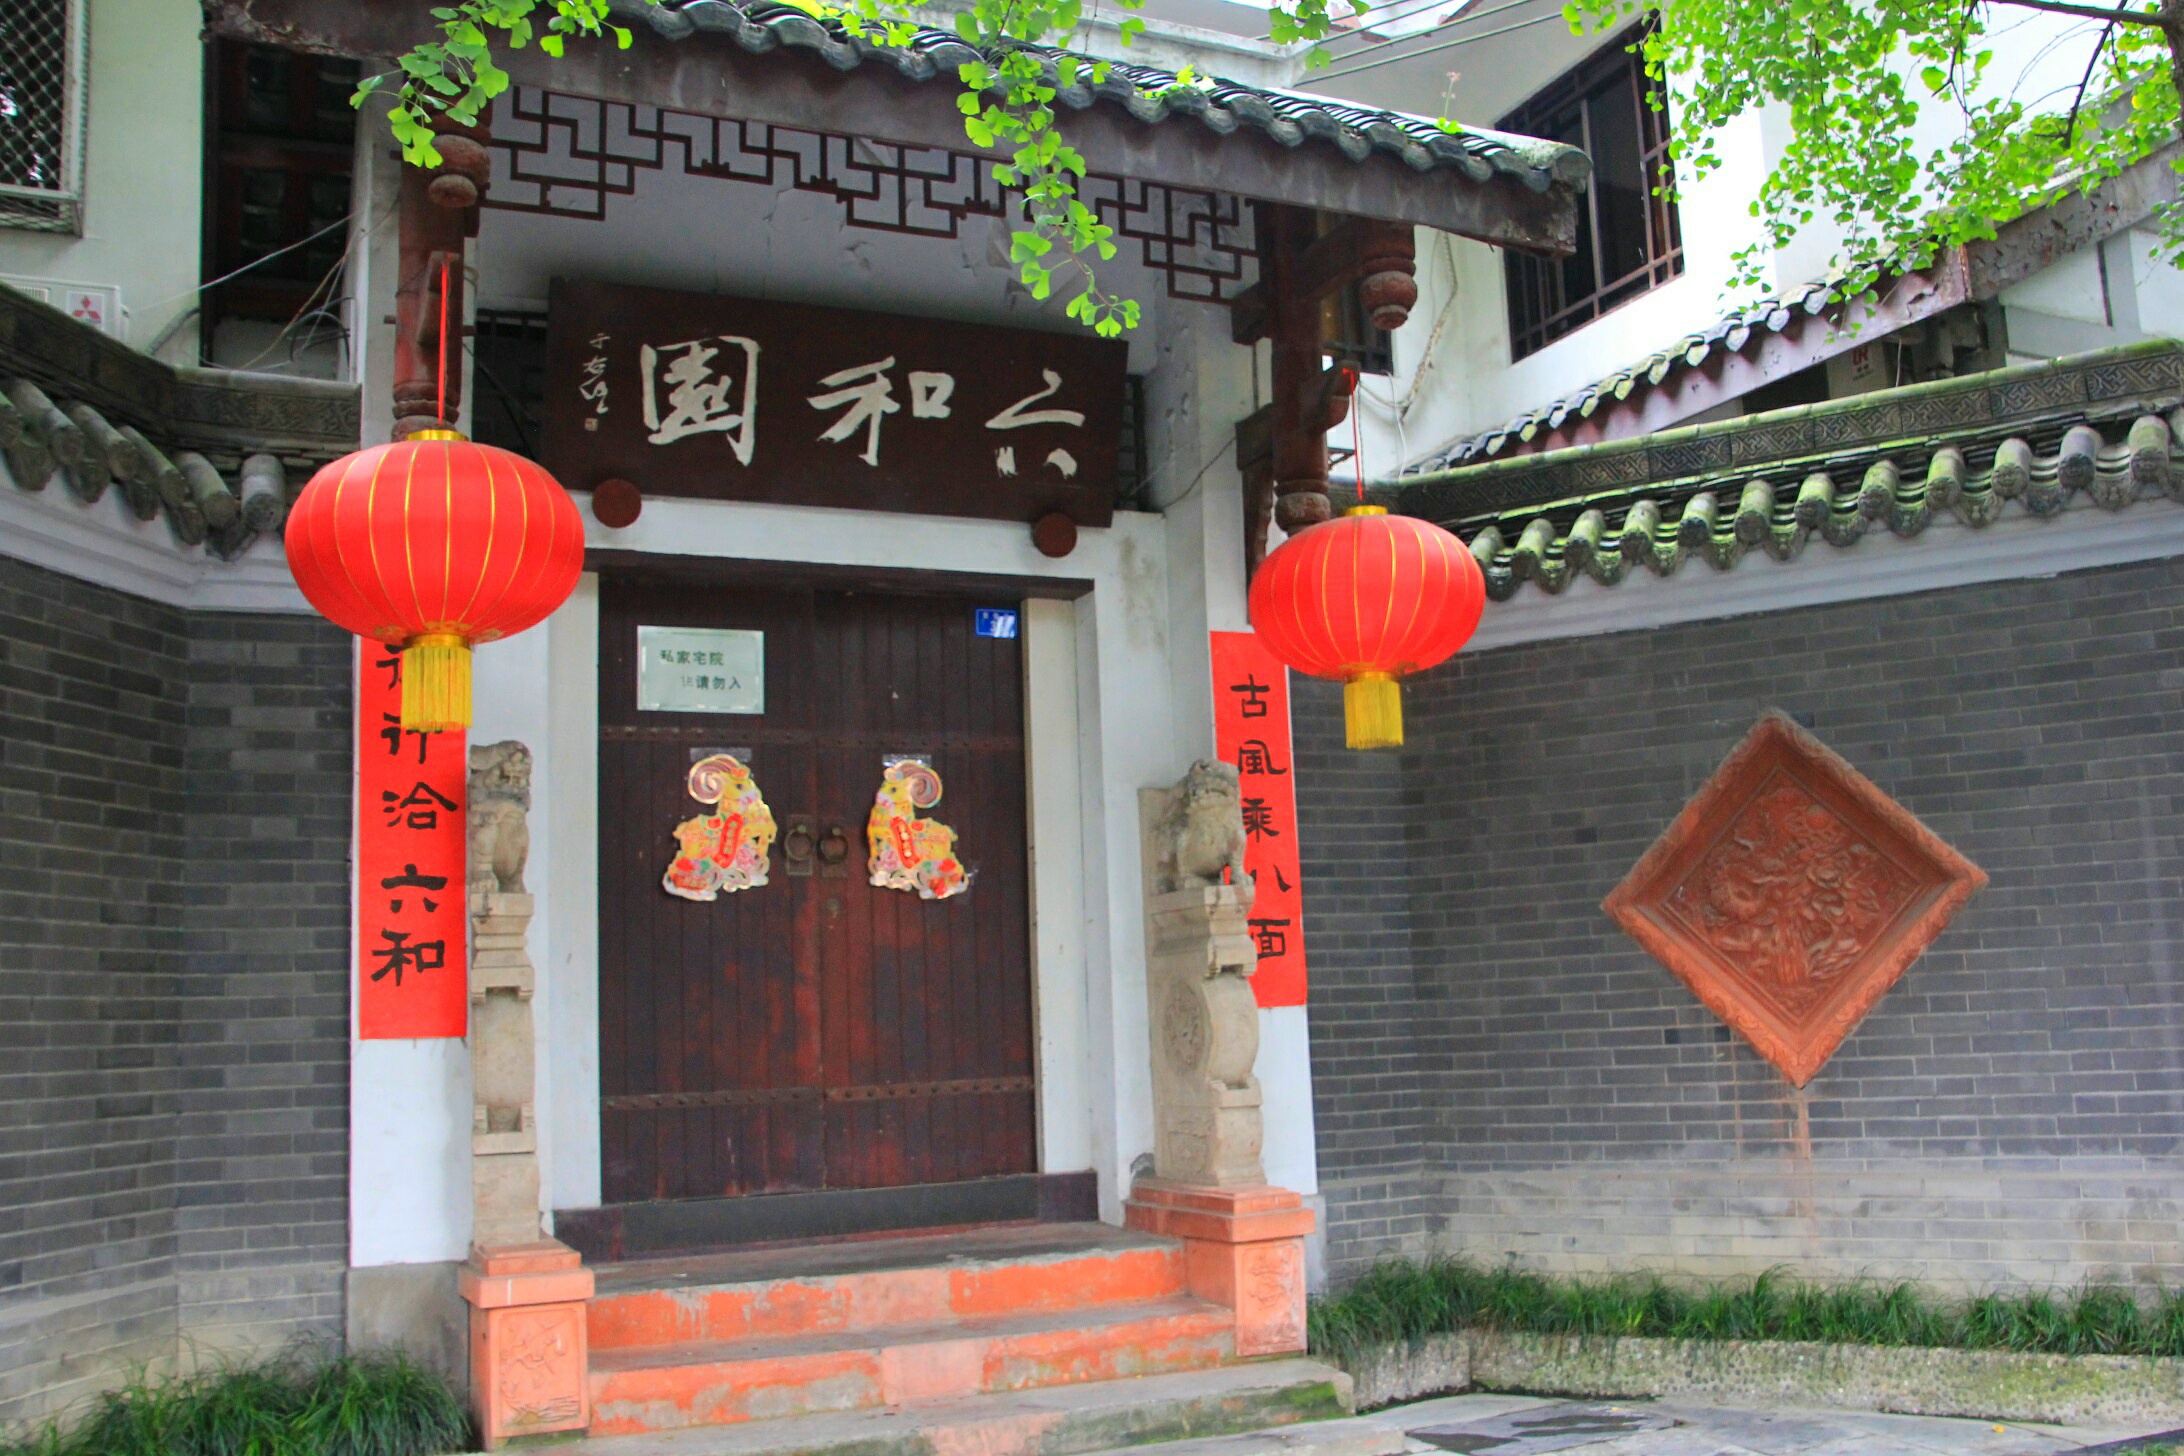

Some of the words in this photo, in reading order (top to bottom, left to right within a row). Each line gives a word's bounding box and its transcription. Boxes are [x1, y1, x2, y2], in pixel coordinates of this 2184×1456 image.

[640, 335, 1085, 478] 六和園
[660, 650, 724, 666] 私家宅院
